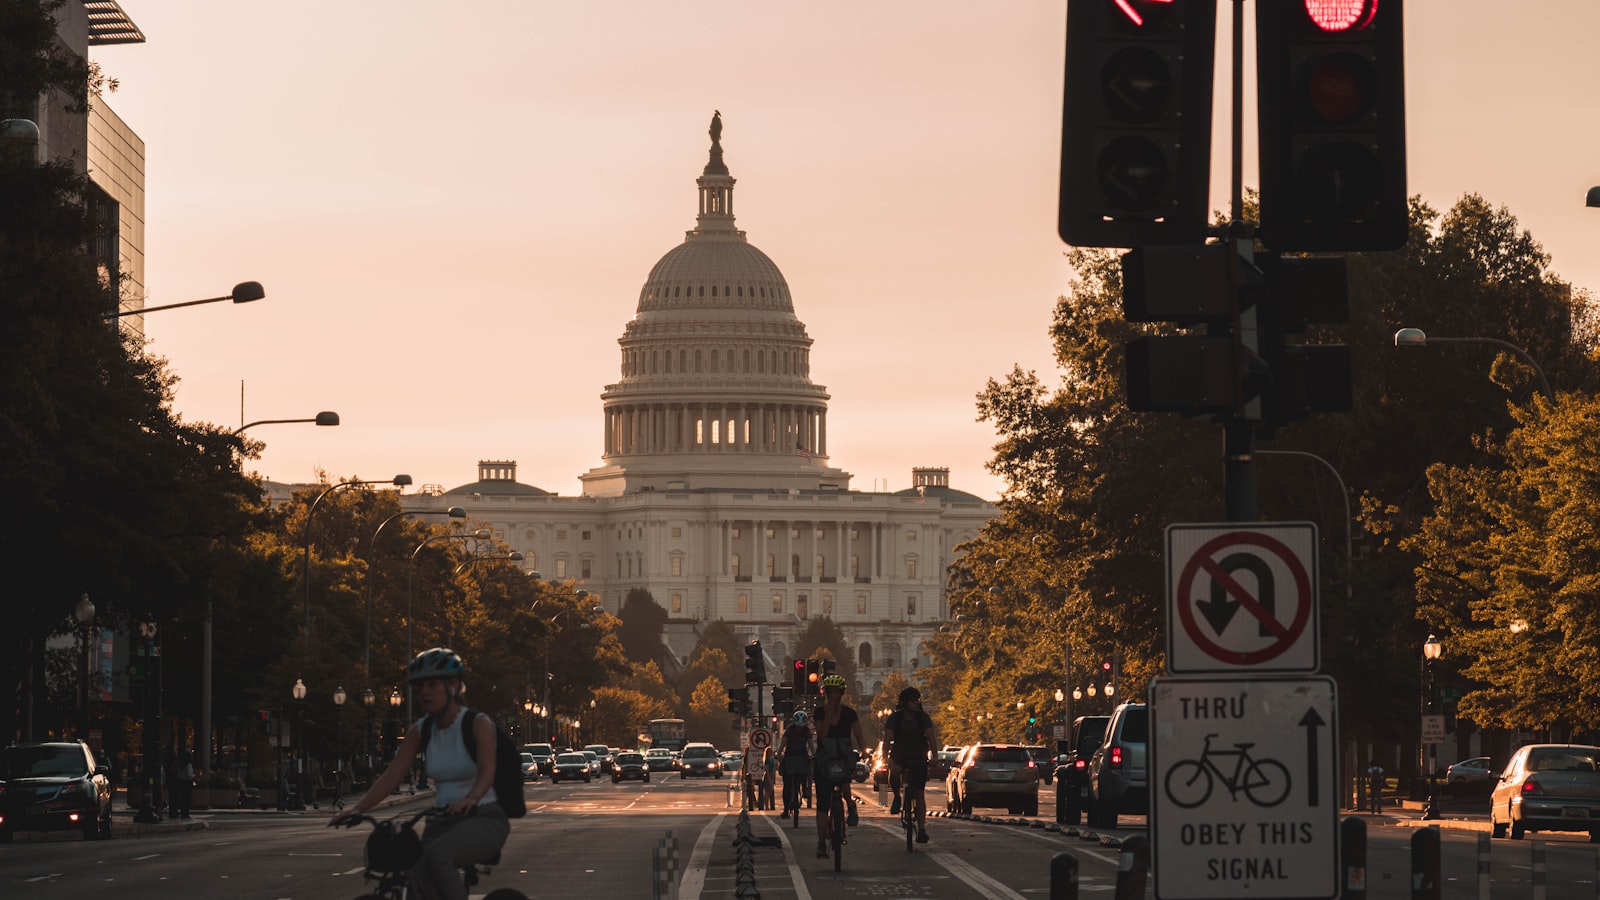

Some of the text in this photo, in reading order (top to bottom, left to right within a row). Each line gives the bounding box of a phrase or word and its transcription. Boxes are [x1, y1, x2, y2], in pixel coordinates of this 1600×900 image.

[1180, 697, 1246, 719] THRU
[1180, 822, 1313, 846] OBEY THIS
[1208, 858, 1289, 881] SIGNAL
